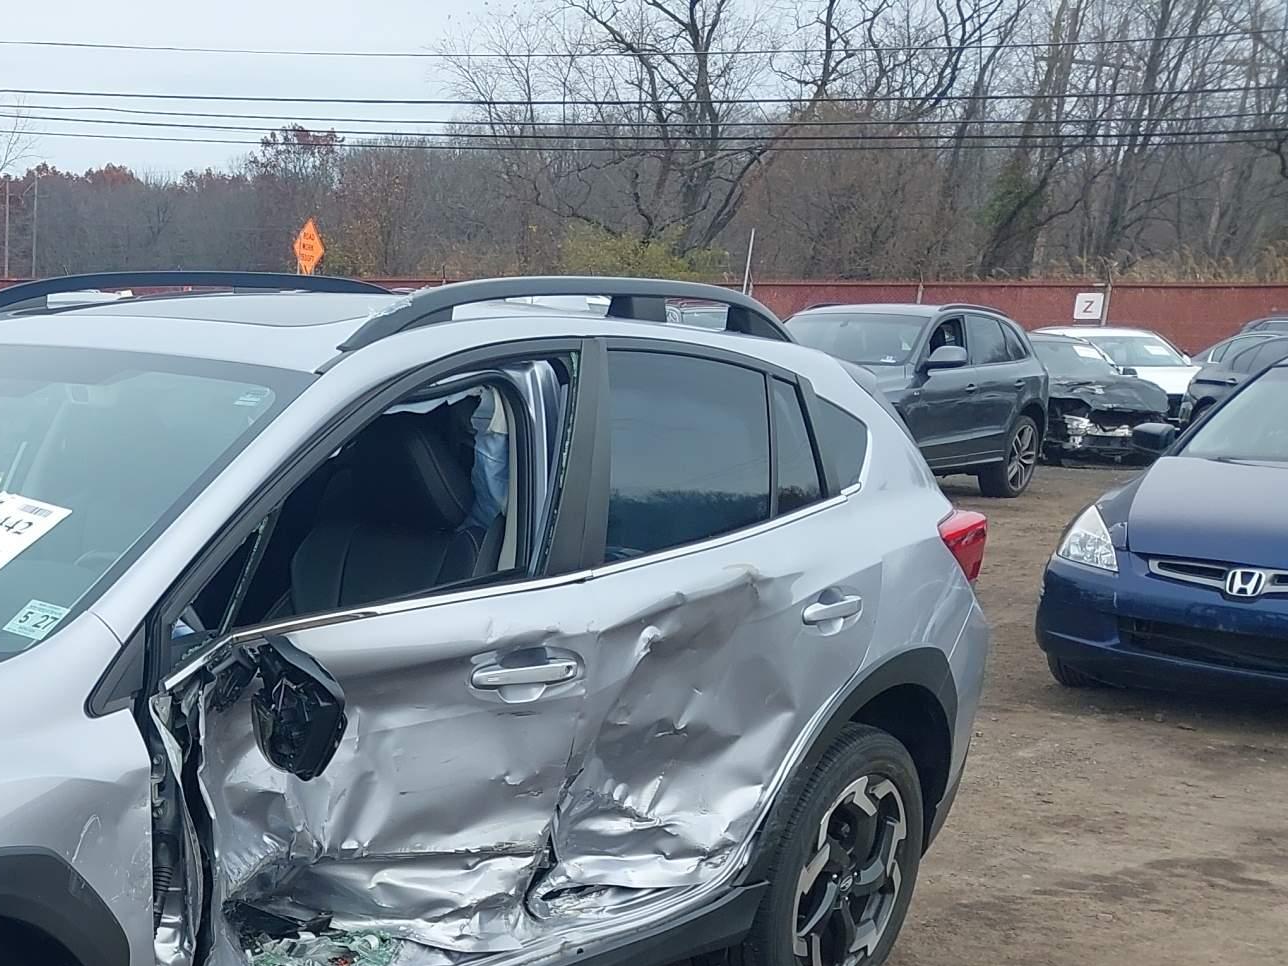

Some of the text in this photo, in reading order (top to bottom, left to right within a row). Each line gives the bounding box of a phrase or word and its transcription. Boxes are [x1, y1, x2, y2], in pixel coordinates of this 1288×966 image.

[1083, 300, 1095, 313] Z
[19, 611, 59, 629] 5 27
